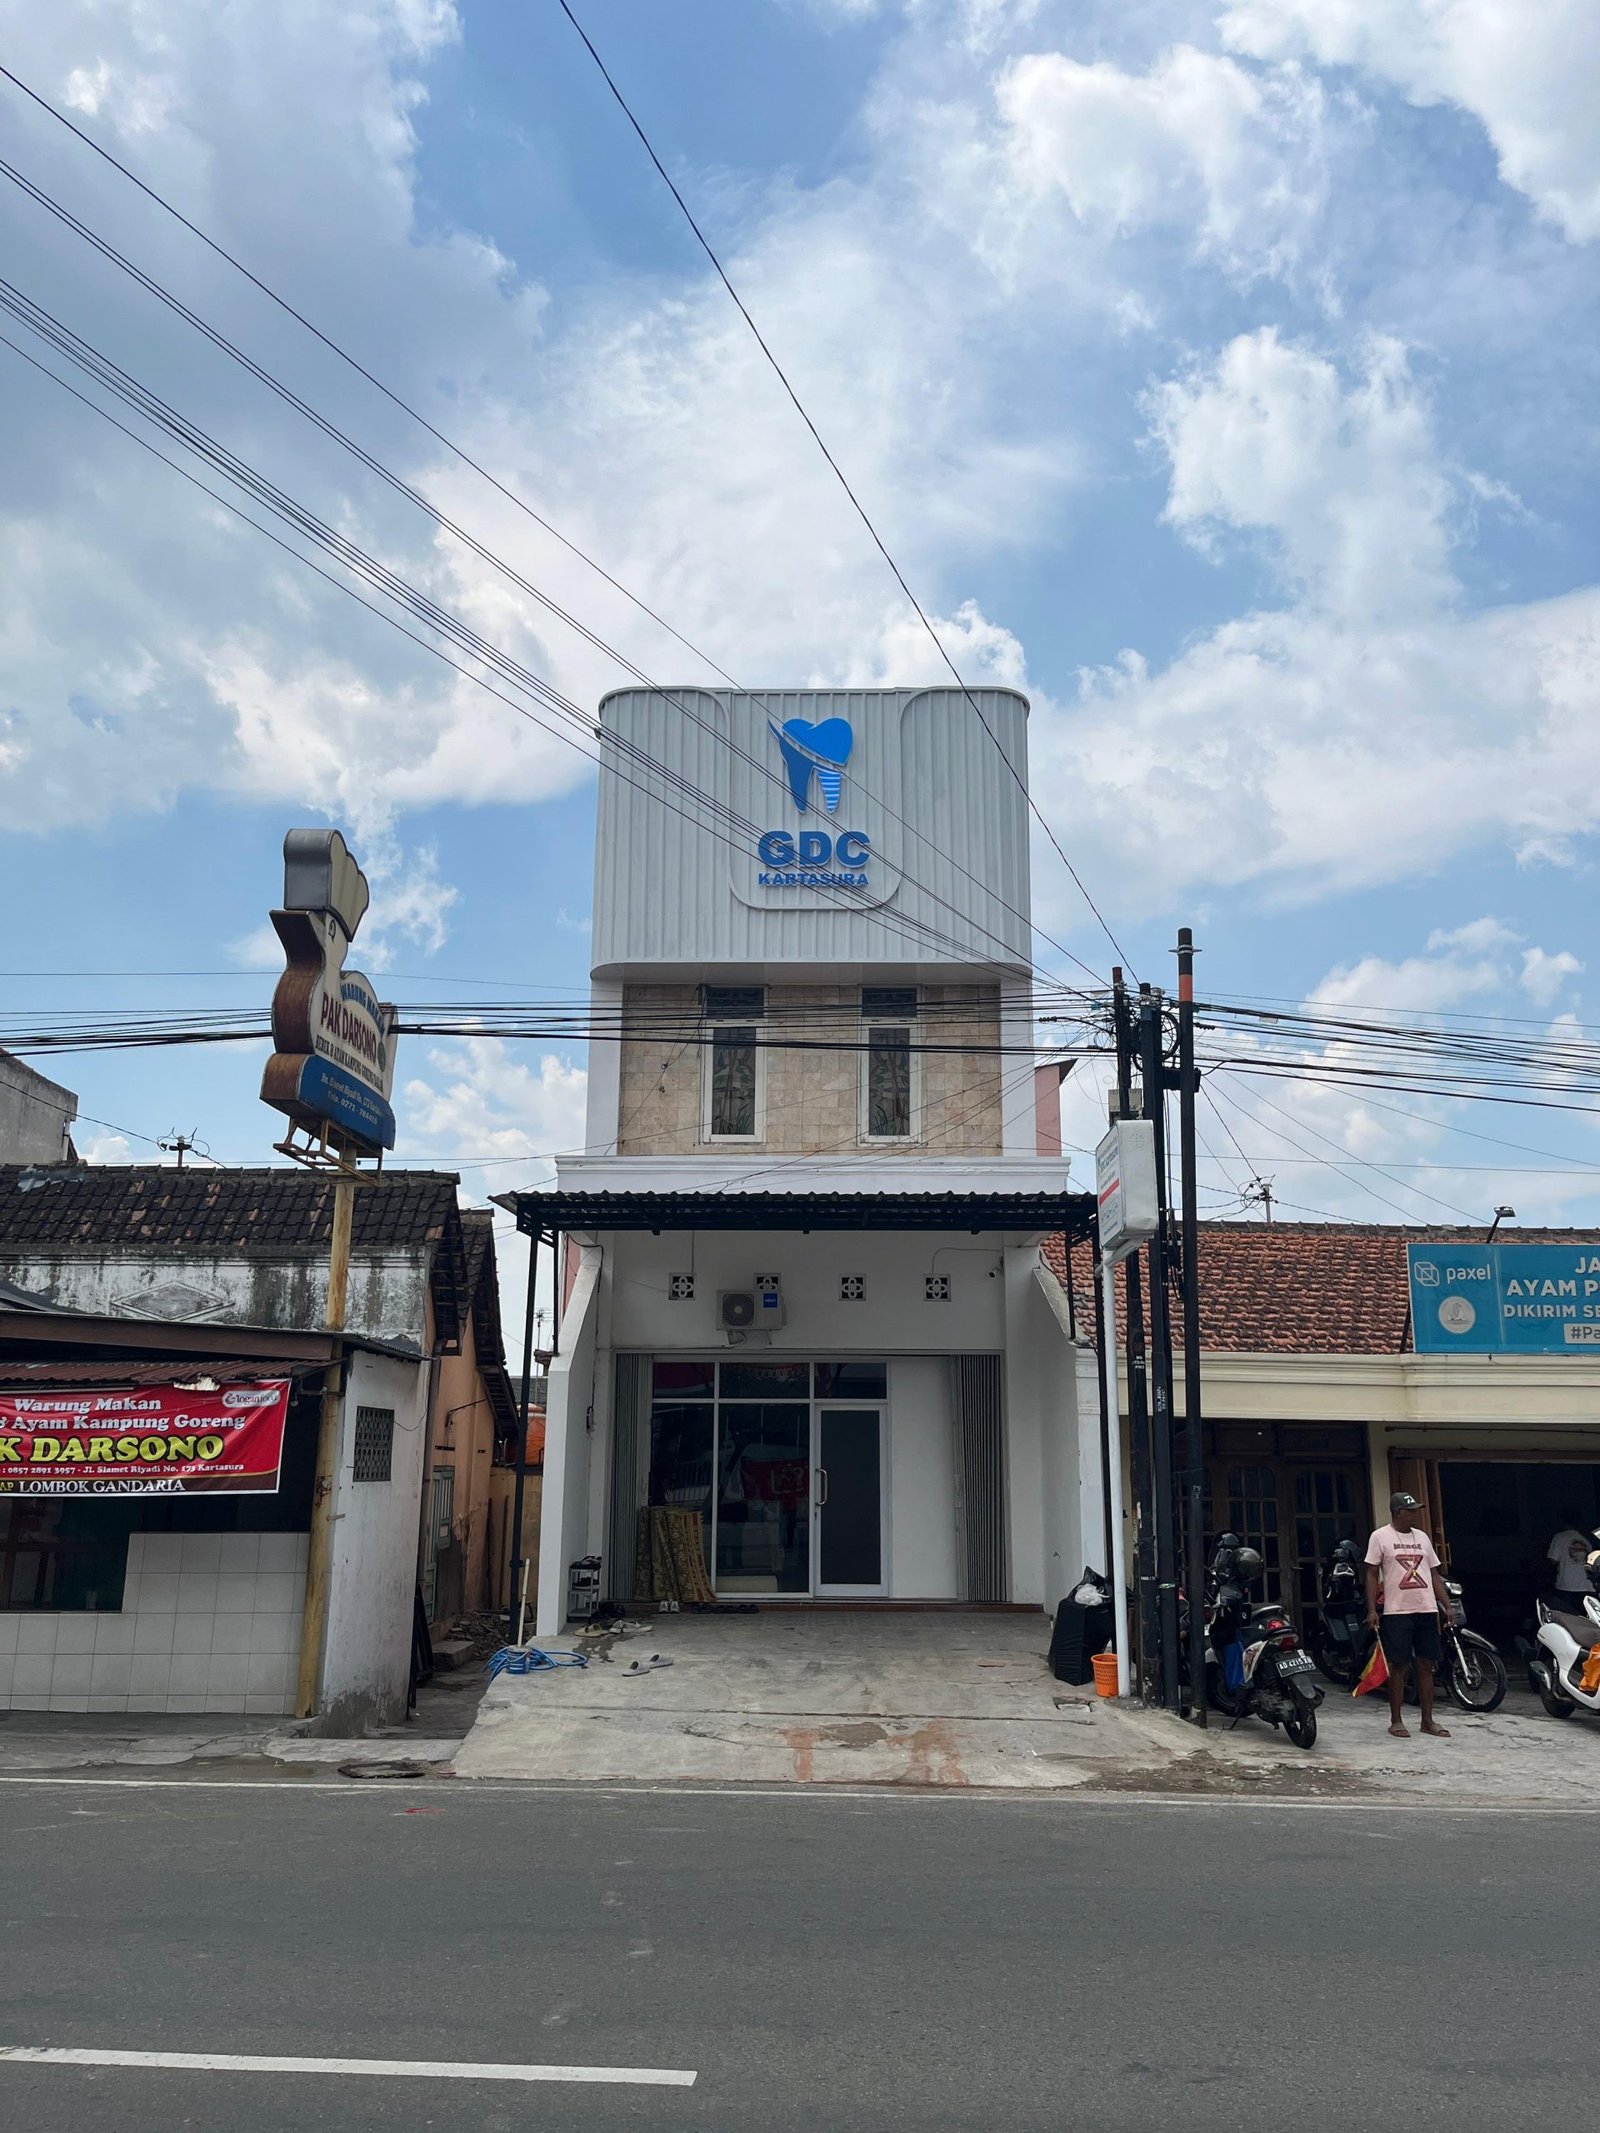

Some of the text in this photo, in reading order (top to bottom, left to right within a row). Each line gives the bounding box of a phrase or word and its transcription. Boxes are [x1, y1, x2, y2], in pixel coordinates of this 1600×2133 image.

[758, 831, 870, 868] GDC
[758, 873, 869, 887] KARTASURA
[321, 991, 376, 1065] PAK DARSONO
[1447, 1264, 1491, 1284] paxel
[1506, 1280, 1600, 1296] AYAM P
[1504, 1304, 1577, 1318] DIKIRIM
[15, 1397, 161, 1414] Warung Makan
[11, 1416, 68, 1432] Ayam
[73, 1415, 170, 1431] Kampung
[174, 1414, 246, 1430] Goreng
[30, 1435, 223, 1462] DARSONO
[130, 1464, 160, 1474] Riyadi
[163, 1464, 178, 1472] No.
[198, 1463, 244, 1471] Kartasura
[19, 1481, 89, 1493] LOMBOK
[92, 1479, 186, 1492] GANDARIA
